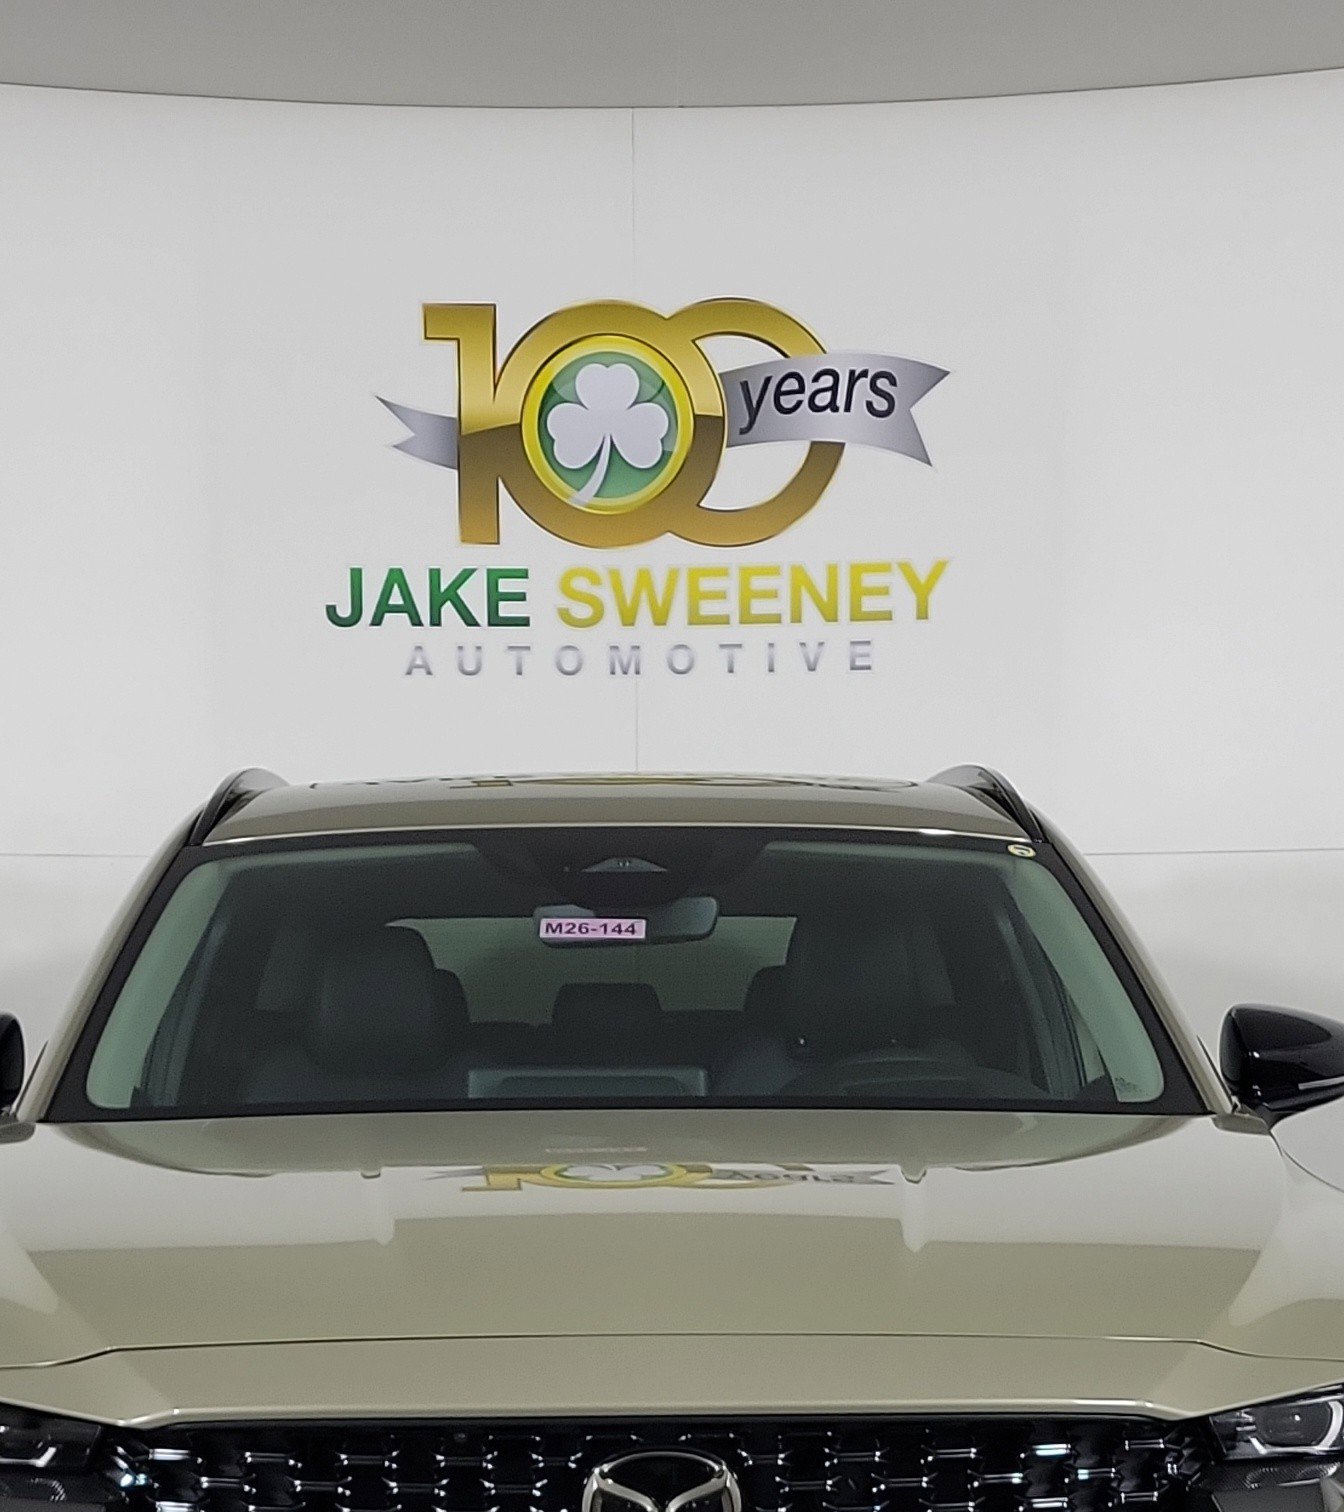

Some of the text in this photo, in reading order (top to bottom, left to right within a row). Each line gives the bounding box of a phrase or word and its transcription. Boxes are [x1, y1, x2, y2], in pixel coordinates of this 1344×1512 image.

[423, 296, 899, 548] 100 years
[326, 561, 949, 628] JAKE SWEENEY
[405, 641, 873, 676] AUTOMOTIVE
[545, 922, 636, 935] M26-144
